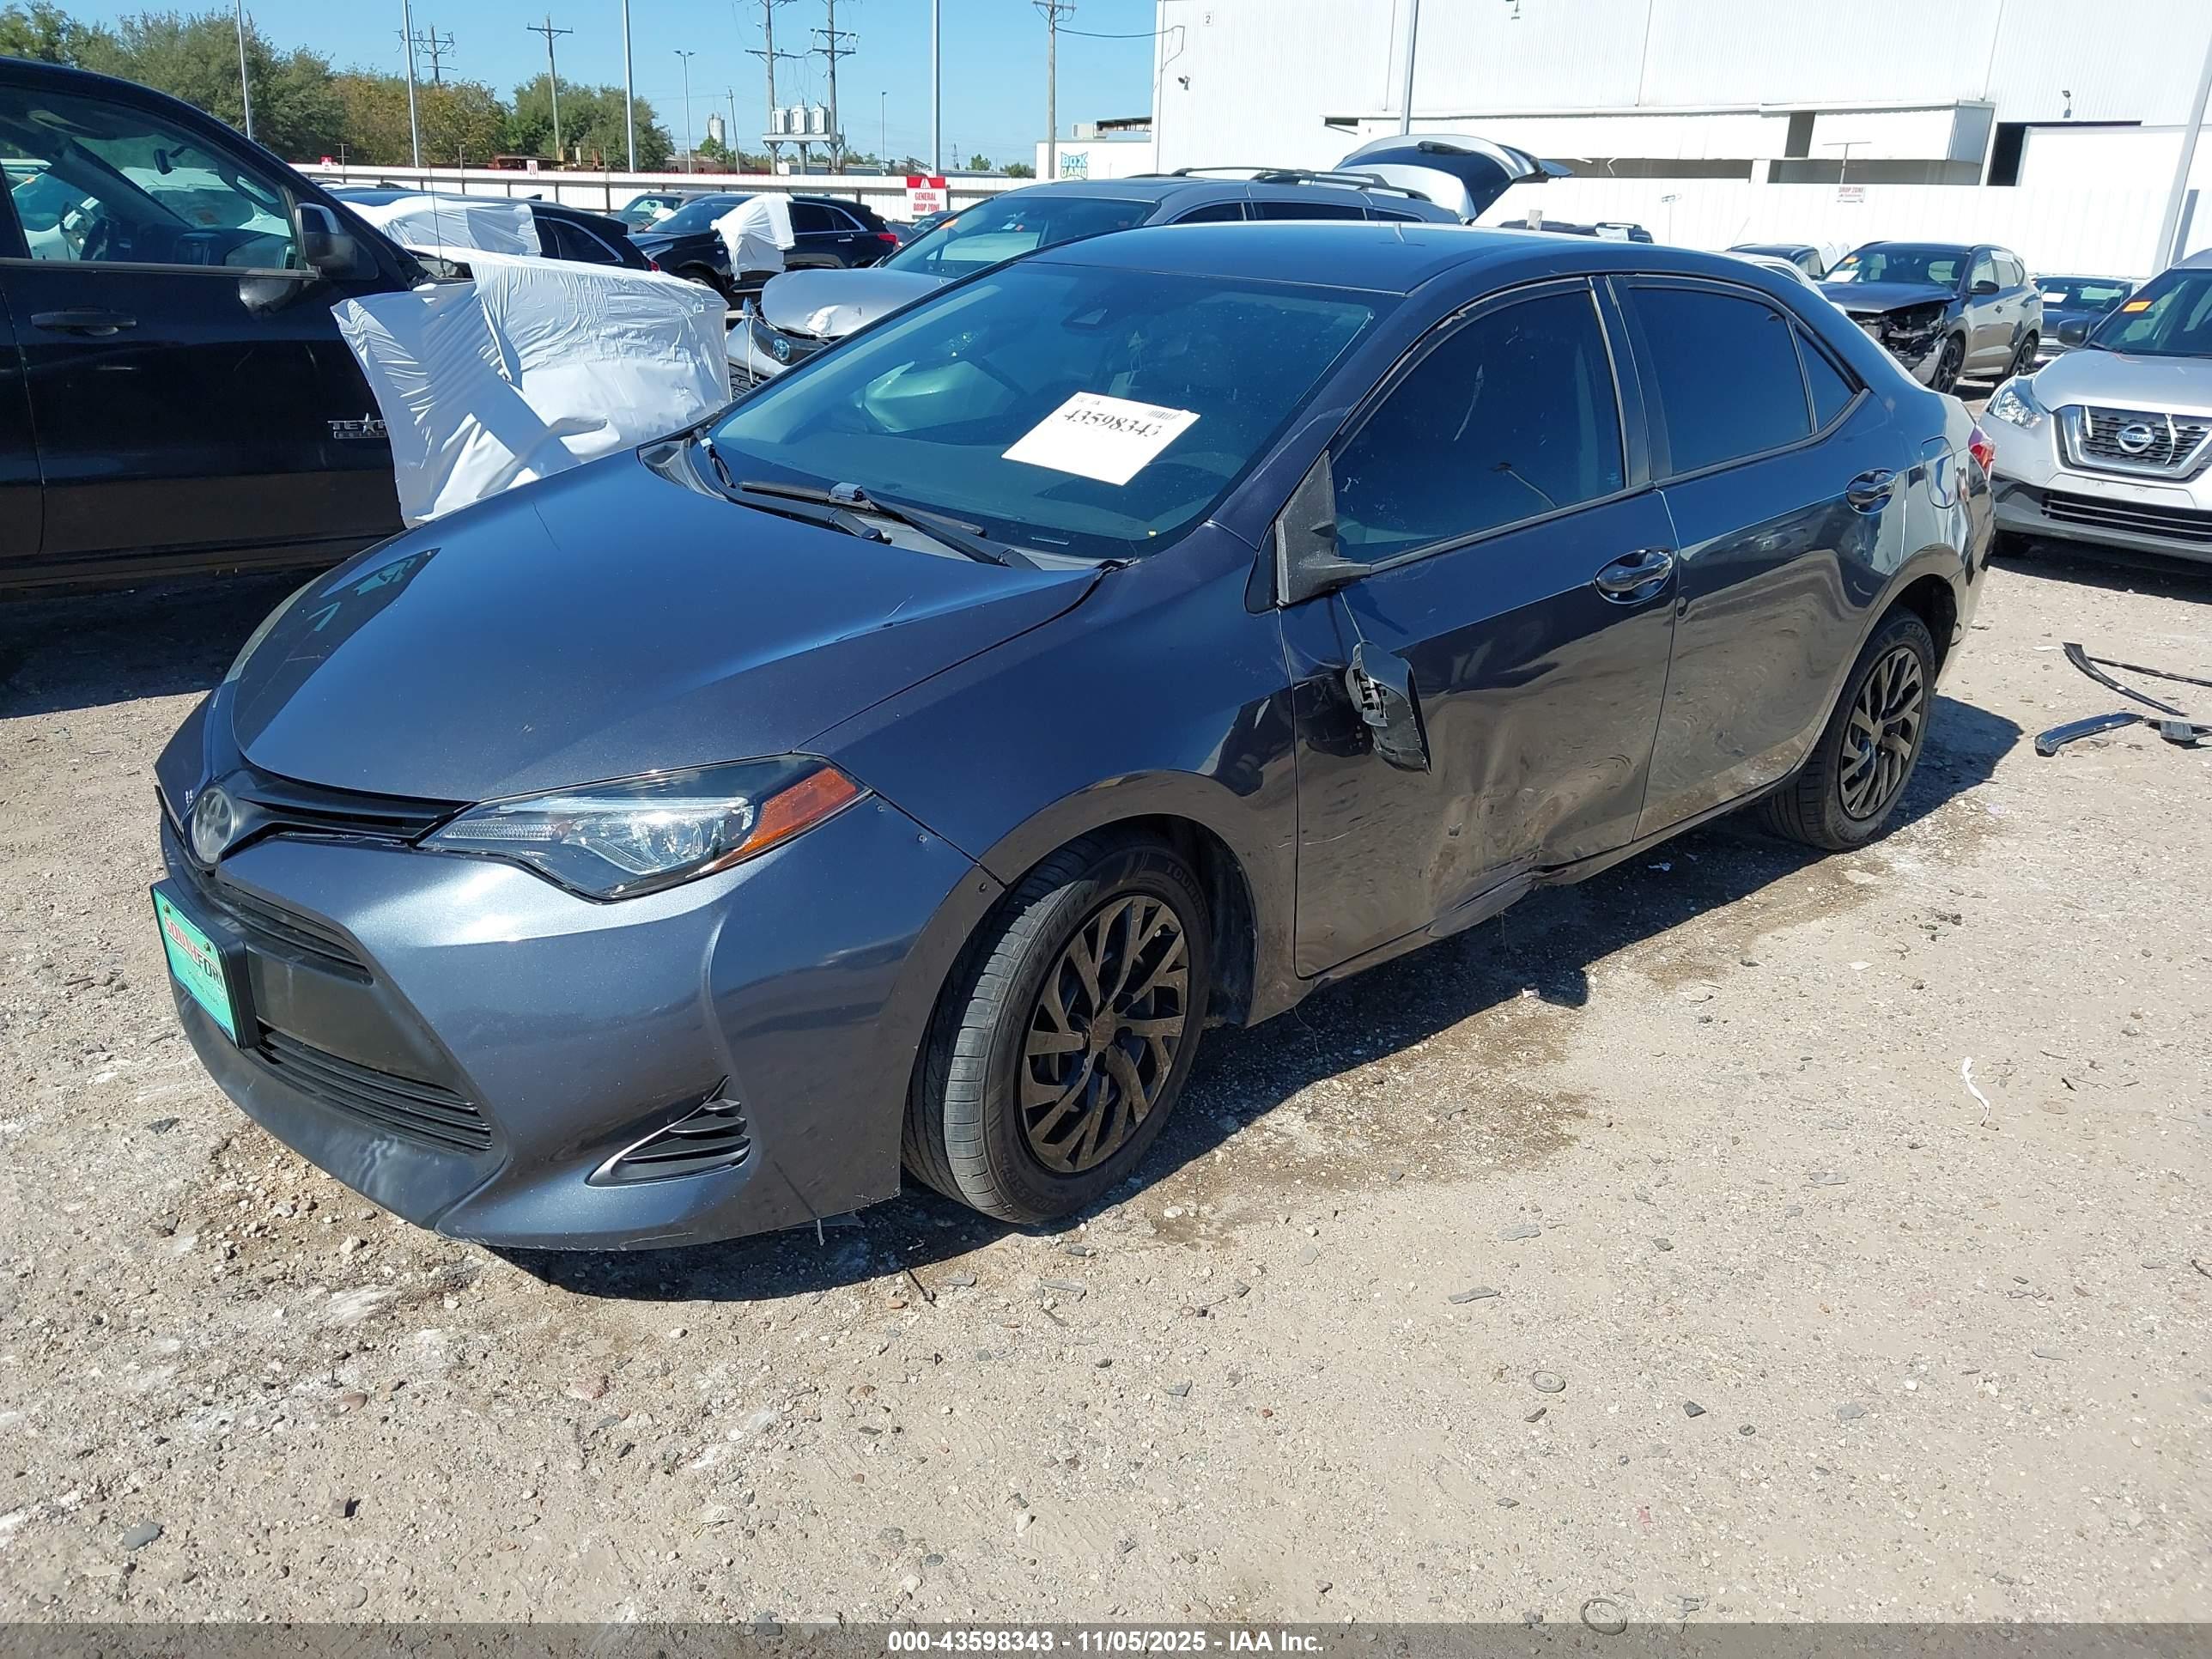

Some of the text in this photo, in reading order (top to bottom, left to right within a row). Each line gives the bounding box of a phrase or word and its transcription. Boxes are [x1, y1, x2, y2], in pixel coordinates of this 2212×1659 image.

[1060, 151, 1088, 167] BOX
[528, 163, 537, 175] 20
[1060, 167, 1088, 180] GANG
[915, 191, 936, 201] GENERAL
[913, 203, 940, 212] DROP ZONE
[1064, 409, 1163, 437] 43598343
[2119, 432, 2150, 441] NISSAN
